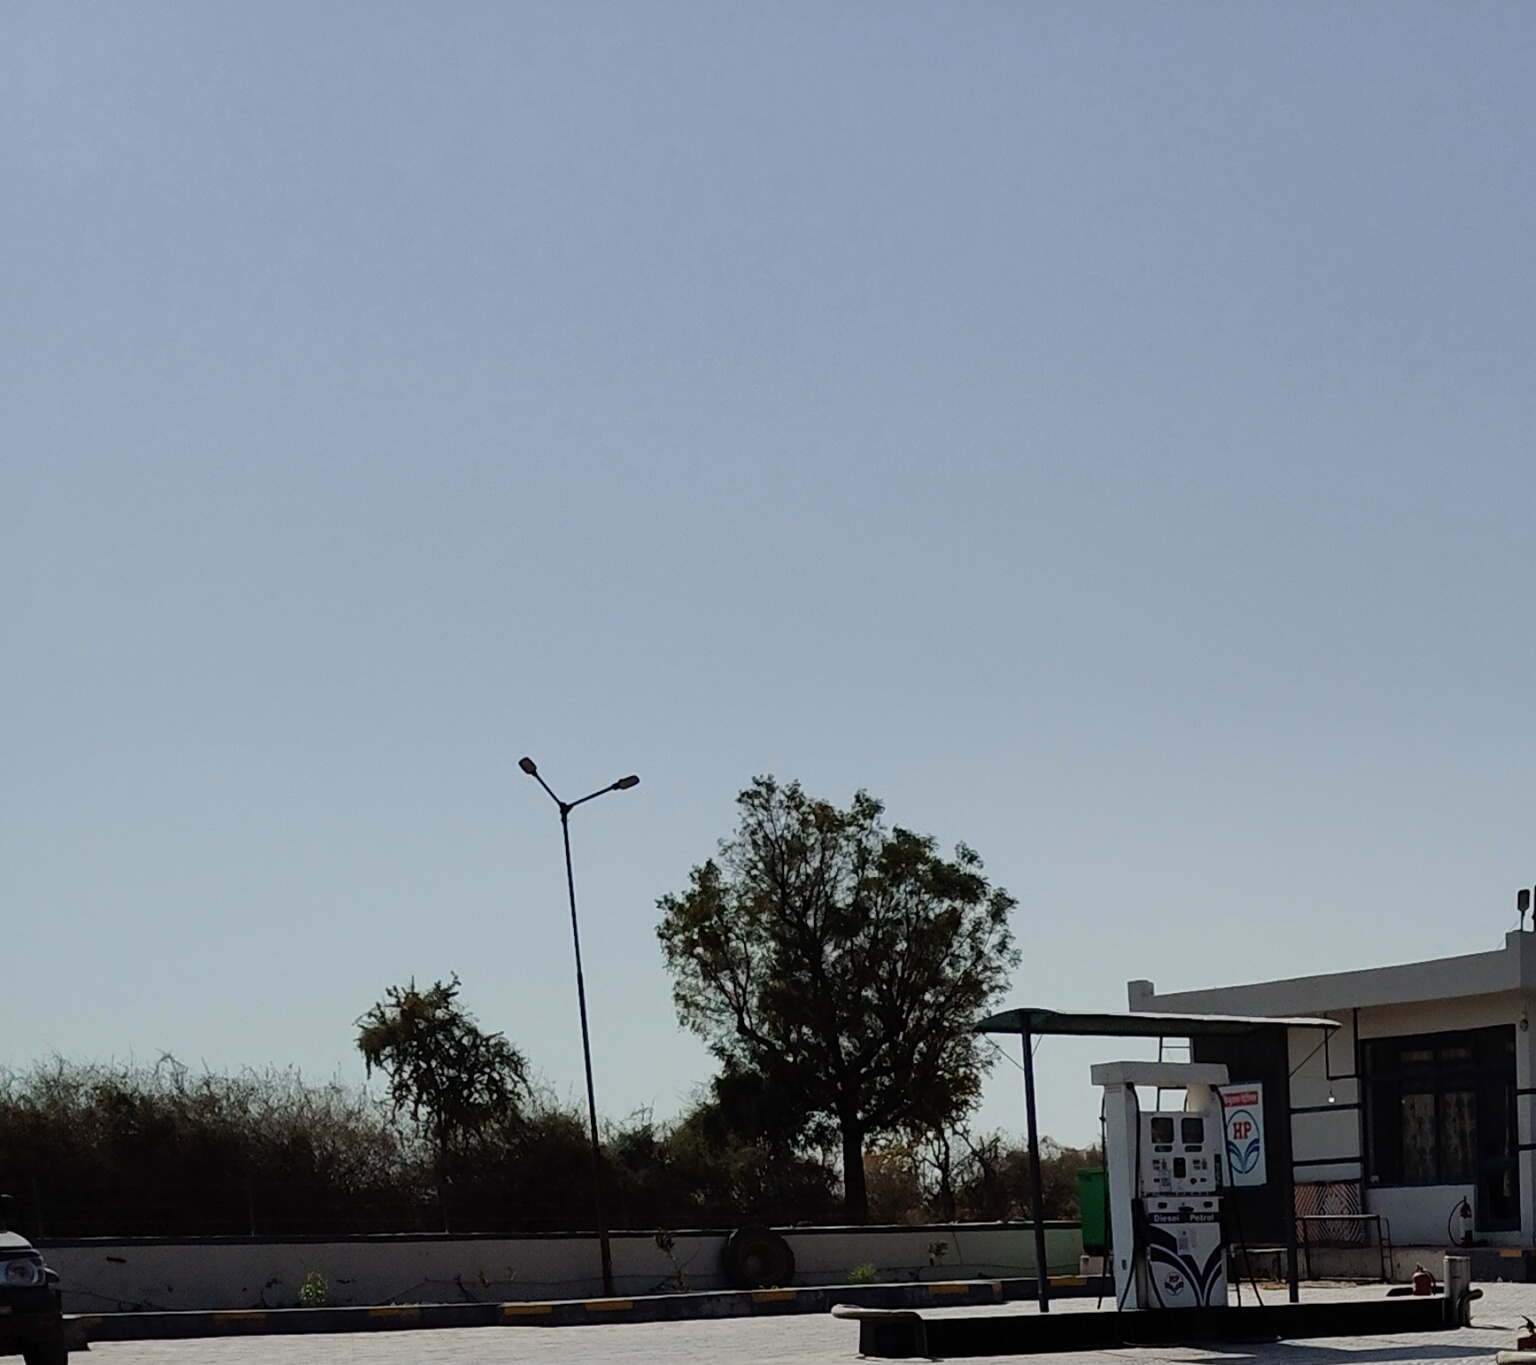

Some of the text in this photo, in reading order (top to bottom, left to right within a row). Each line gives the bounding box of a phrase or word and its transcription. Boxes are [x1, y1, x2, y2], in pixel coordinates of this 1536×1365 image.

[1233, 1121, 1252, 1140] HP
[1153, 1214, 1215, 1222] Diesel Petrol
